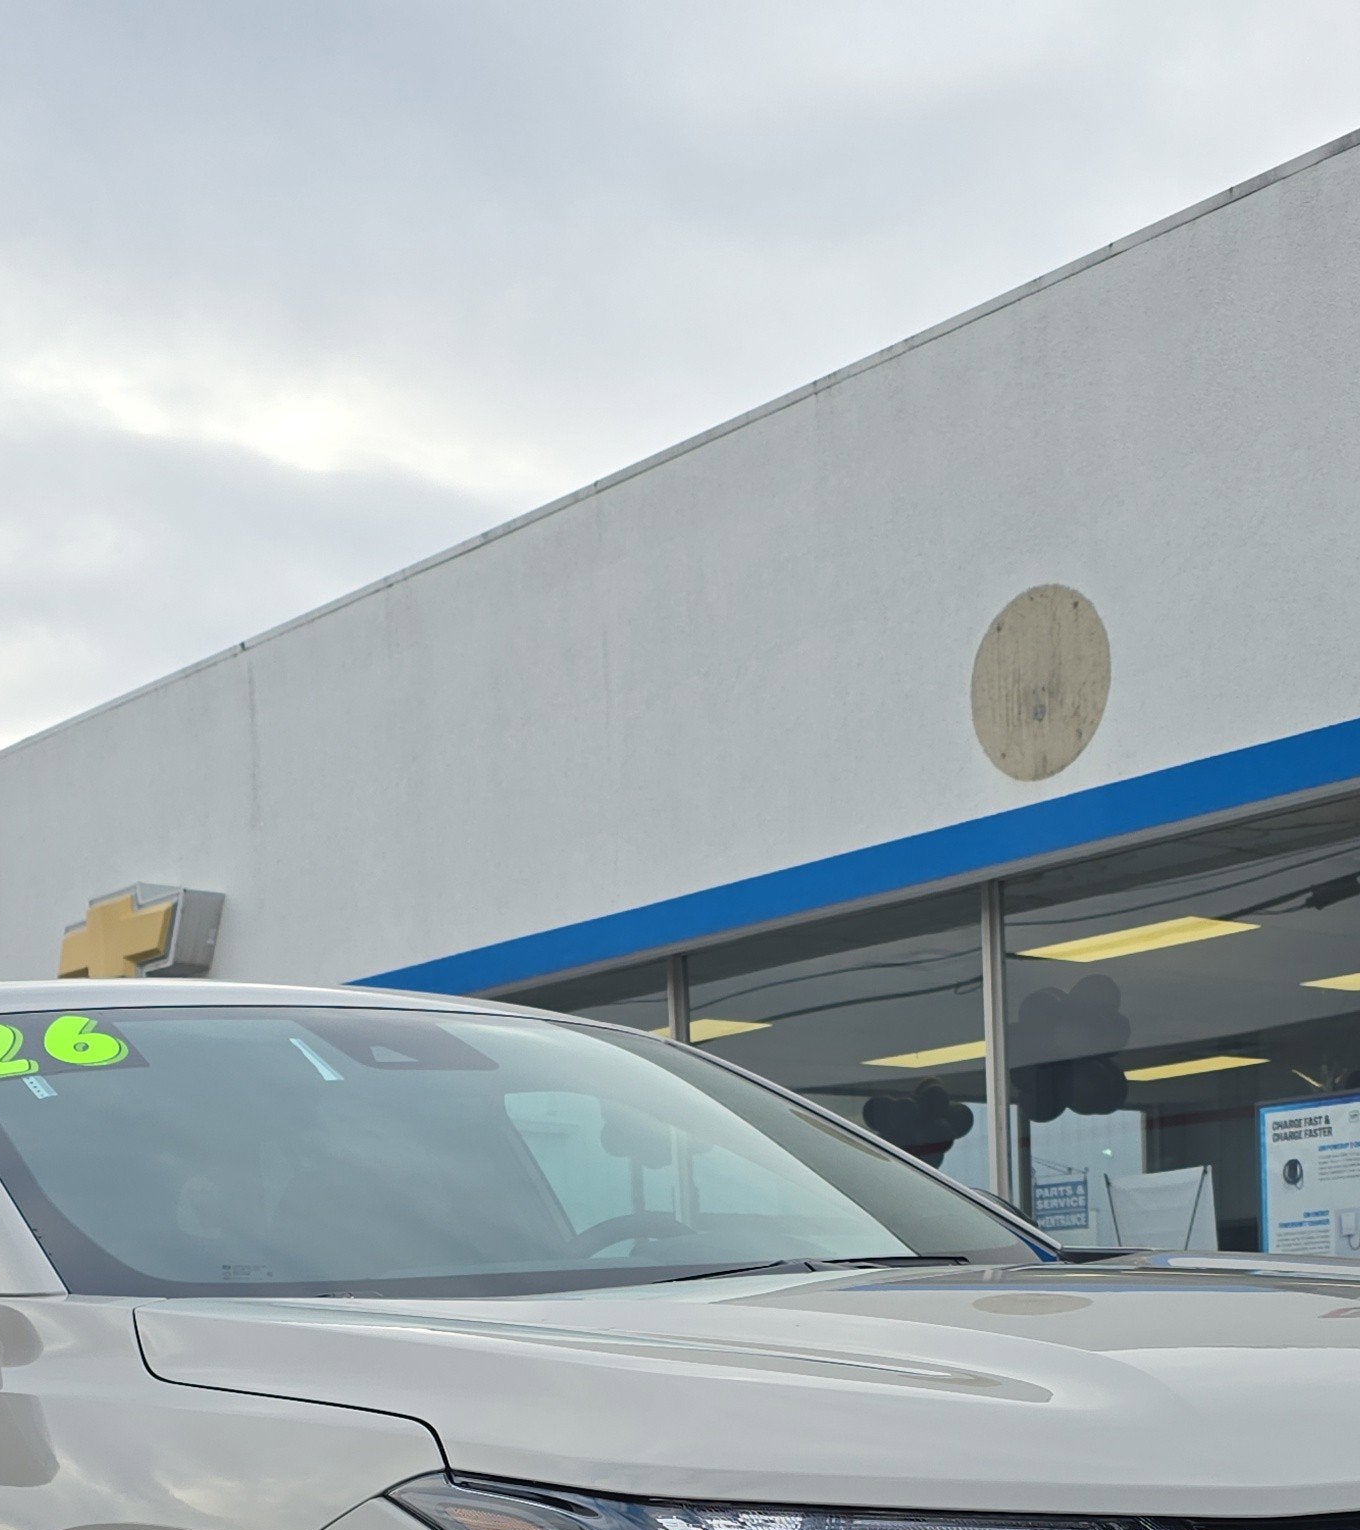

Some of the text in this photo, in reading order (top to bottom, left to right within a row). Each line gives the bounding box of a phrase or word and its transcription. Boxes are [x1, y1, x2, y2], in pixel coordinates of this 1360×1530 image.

[1272, 1115, 1331, 1131] CHARGE FAST &
[1272, 1126, 1333, 1143] CHARGE FASTER
[1035, 1185, 1085, 1198] PARTS &
[1036, 1196, 1086, 1210] SERVICE
